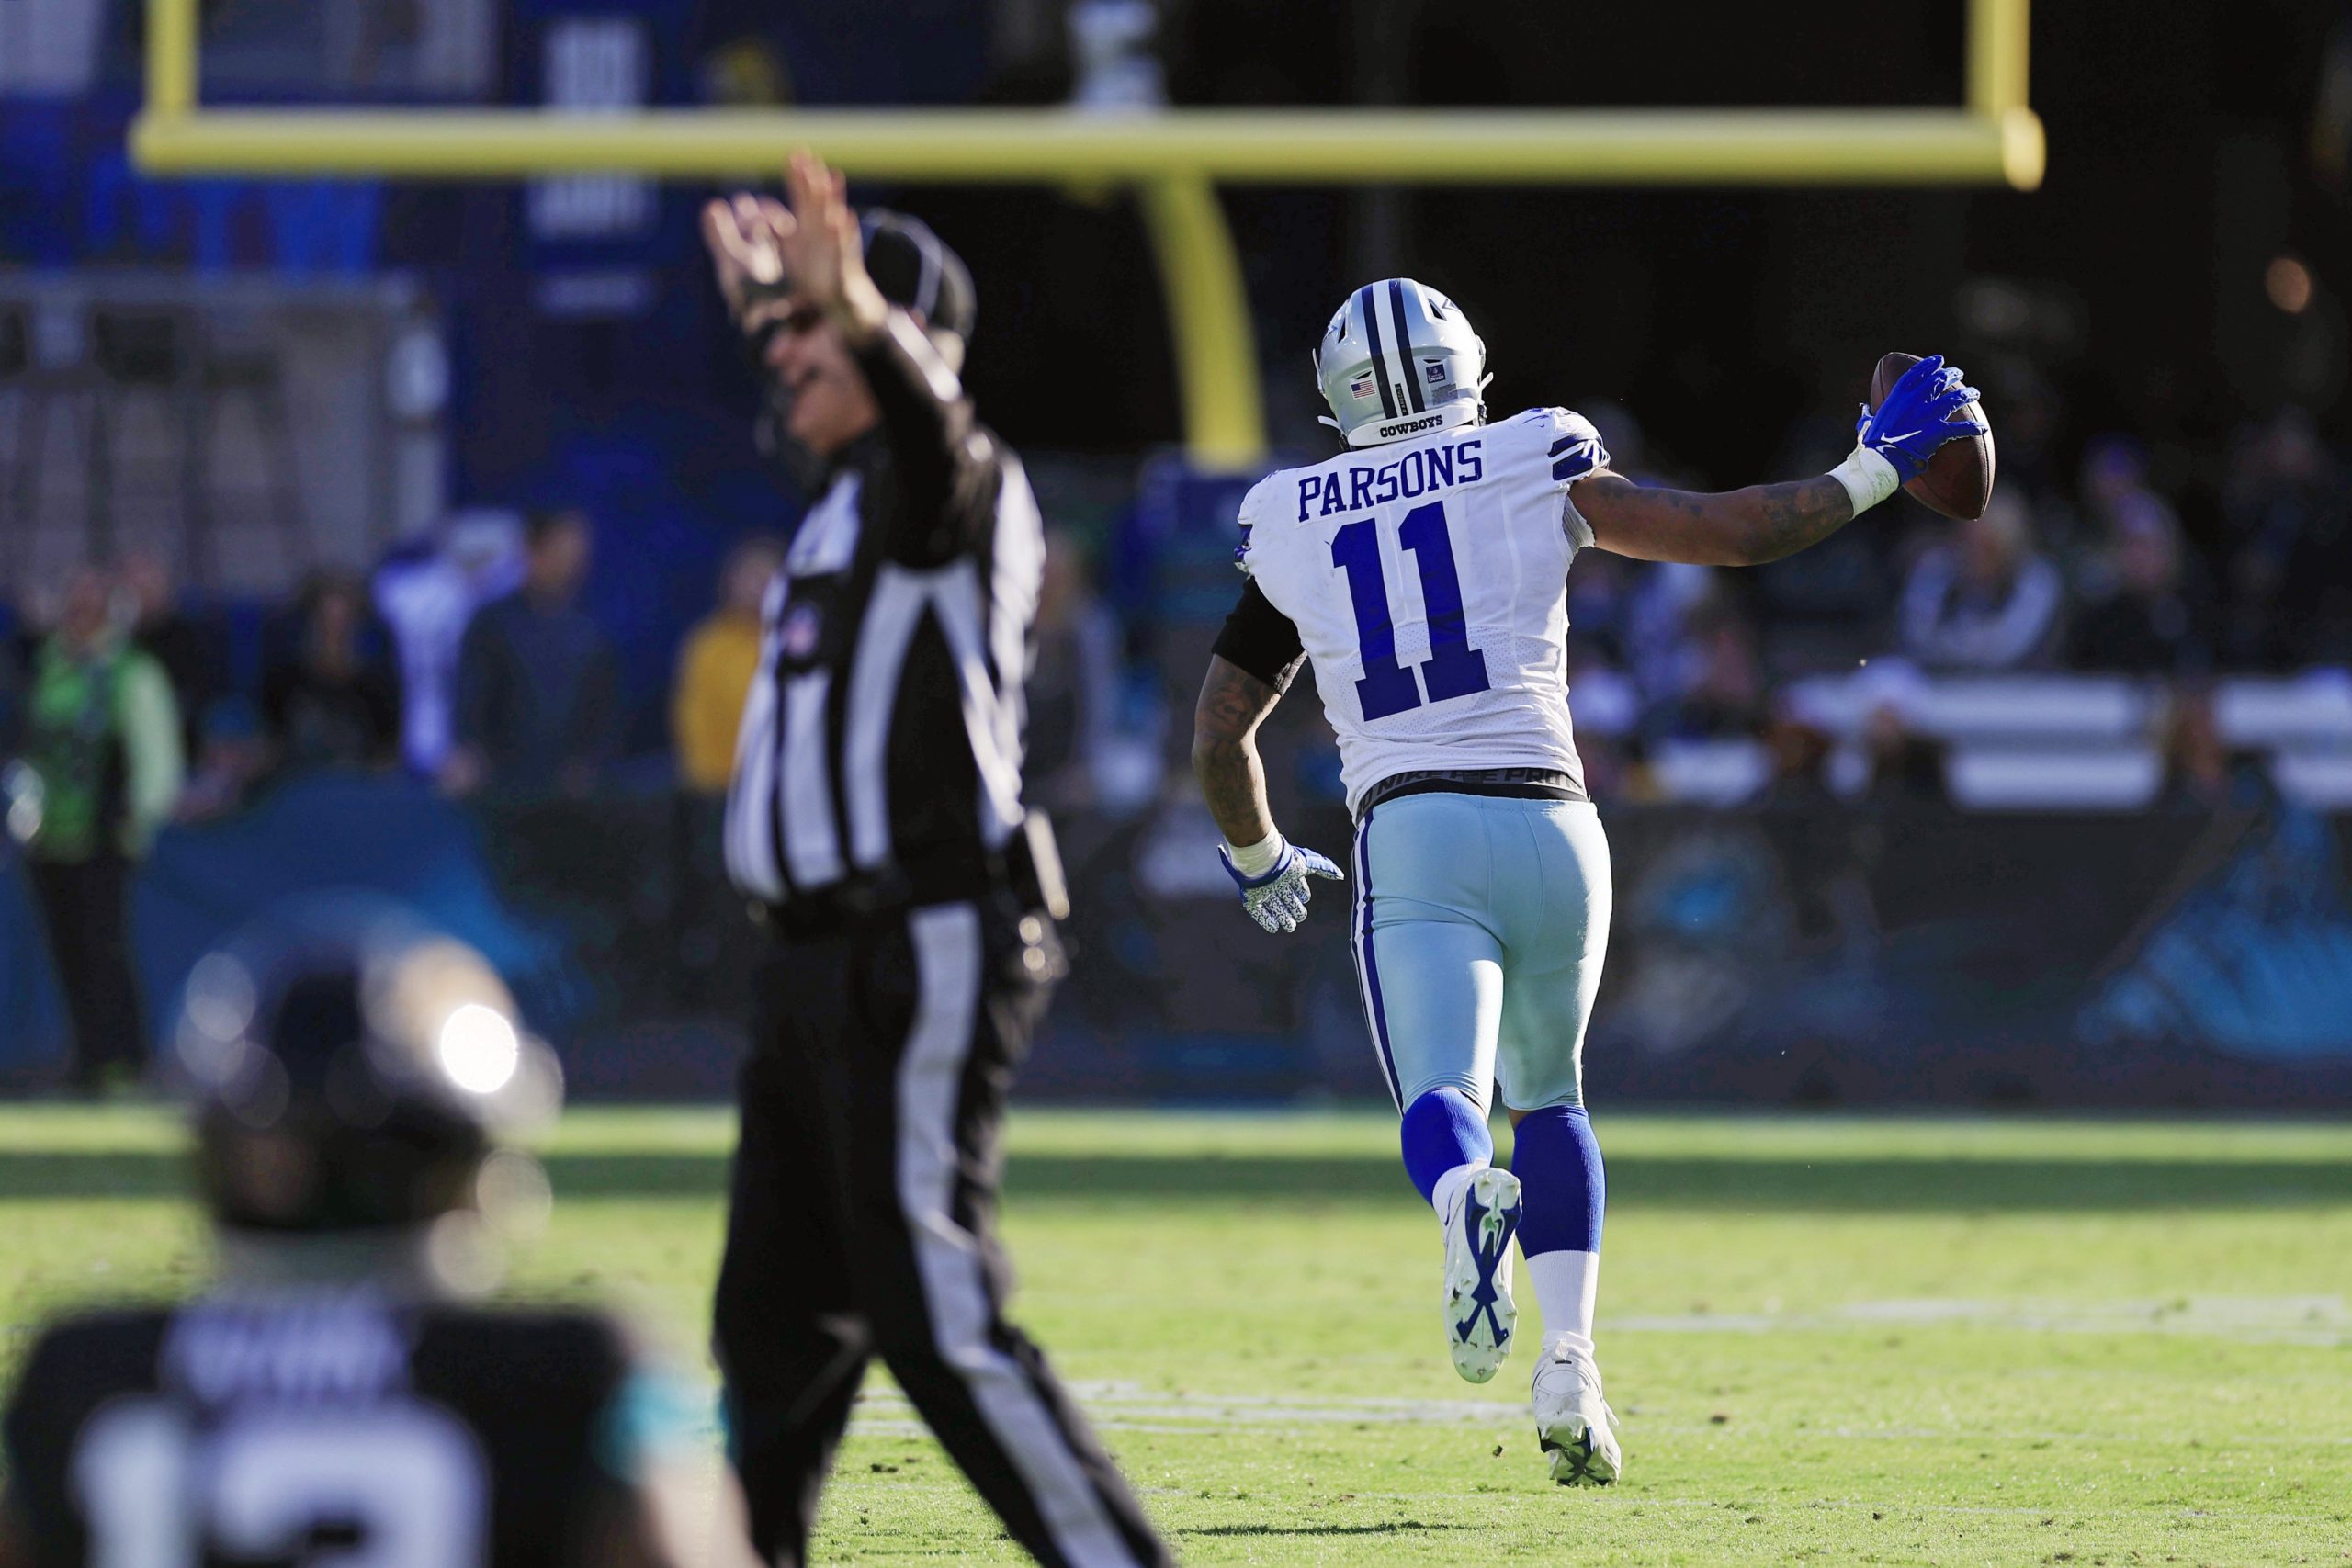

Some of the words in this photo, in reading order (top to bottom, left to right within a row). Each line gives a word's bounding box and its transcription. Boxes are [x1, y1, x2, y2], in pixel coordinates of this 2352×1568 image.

[1379, 414, 1443, 438] COWBOYS
[1298, 439, 1483, 524] PARSONS
[1330, 500, 1491, 722] 11
[1376, 770, 1442, 795] NIKE
